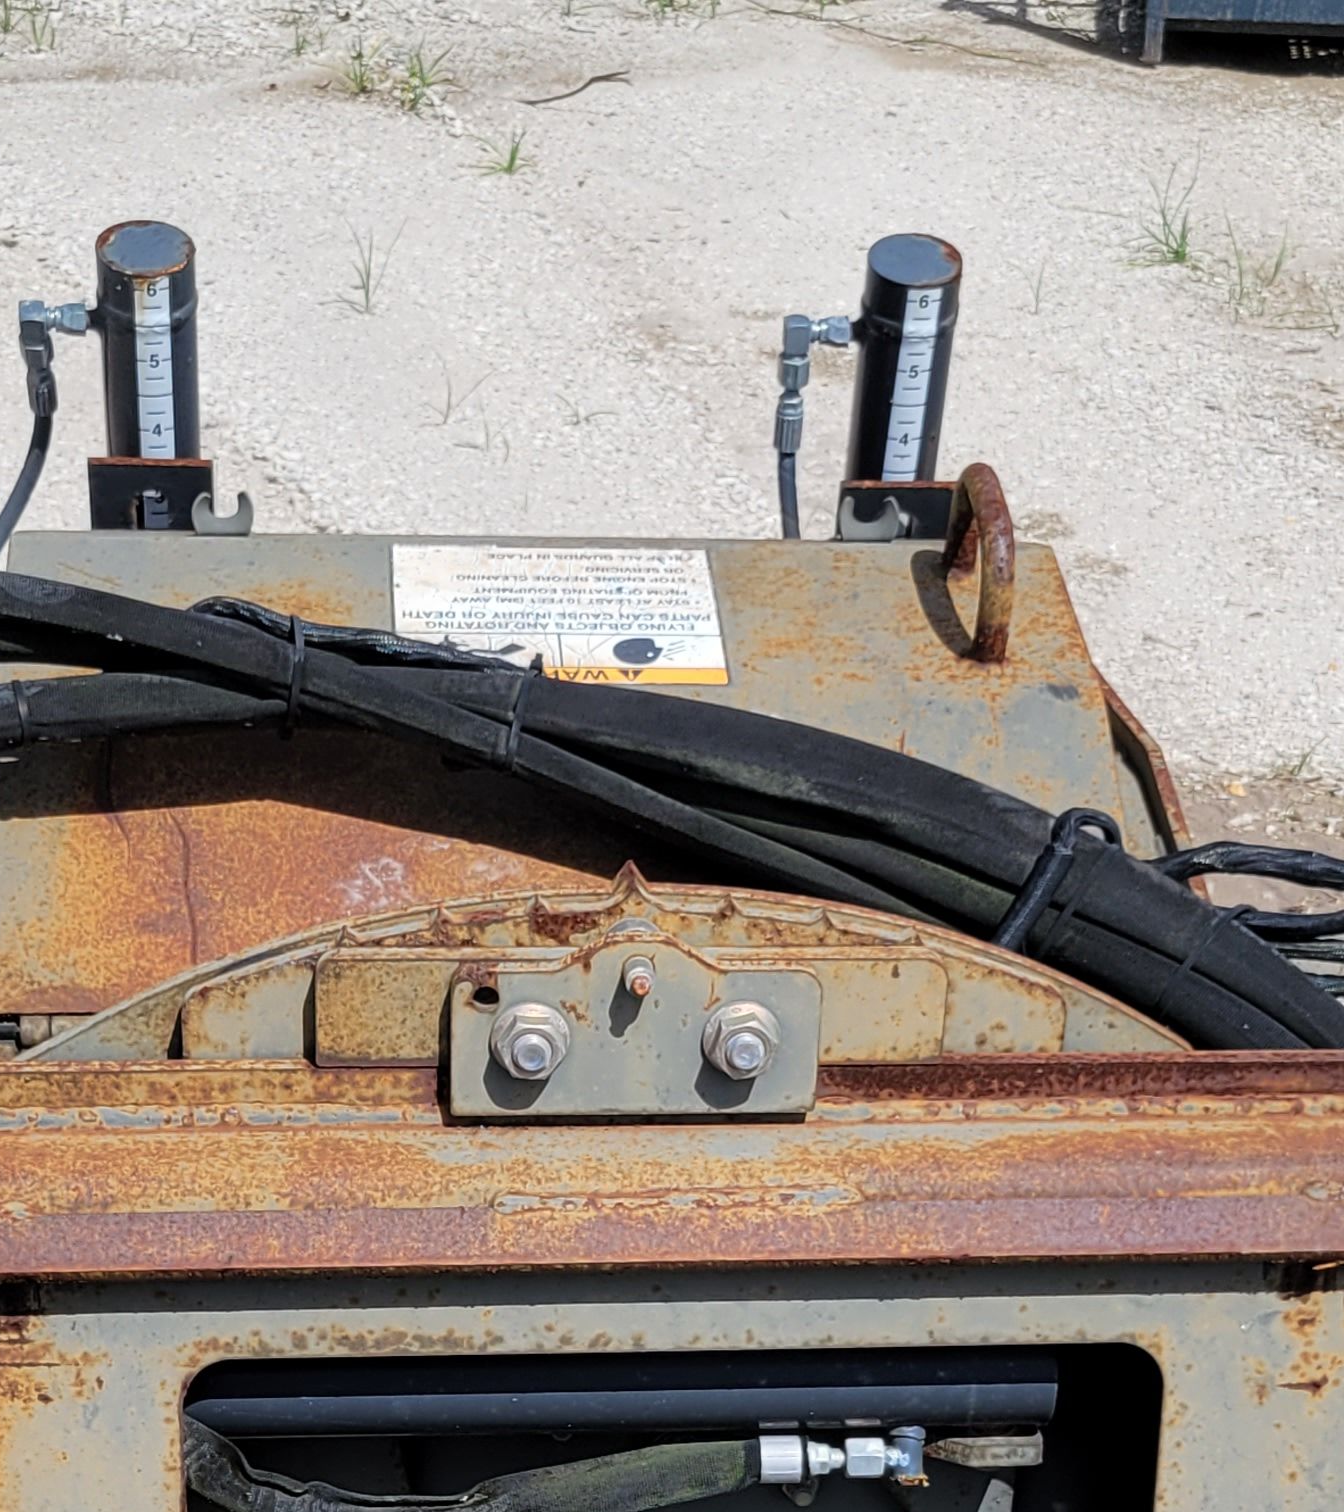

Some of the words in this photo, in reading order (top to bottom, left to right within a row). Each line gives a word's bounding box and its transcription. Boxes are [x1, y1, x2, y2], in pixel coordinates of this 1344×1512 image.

[146, 283, 158, 298] 6
[919, 294, 930, 309] 6
[149, 353, 160, 369] 5
[908, 365, 919, 380] 5
[151, 423, 163, 438] 4
[898, 433, 909, 447] 4
[452, 596, 492, 604] AWAY
[402, 610, 456, 619] DEATH
[462, 610, 487, 620] OR
[492, 611, 552, 620] INJURY
[555, 612, 614, 621] CAUSE
[619, 613, 659, 622] CAN
[660, 613, 711, 622] PARTS
[425, 620, 509, 630] ROTATING
[514, 621, 550, 630] AND
[554, 622, 633, 631] OBJECTS
[637, 623, 695, 631] FLYING
